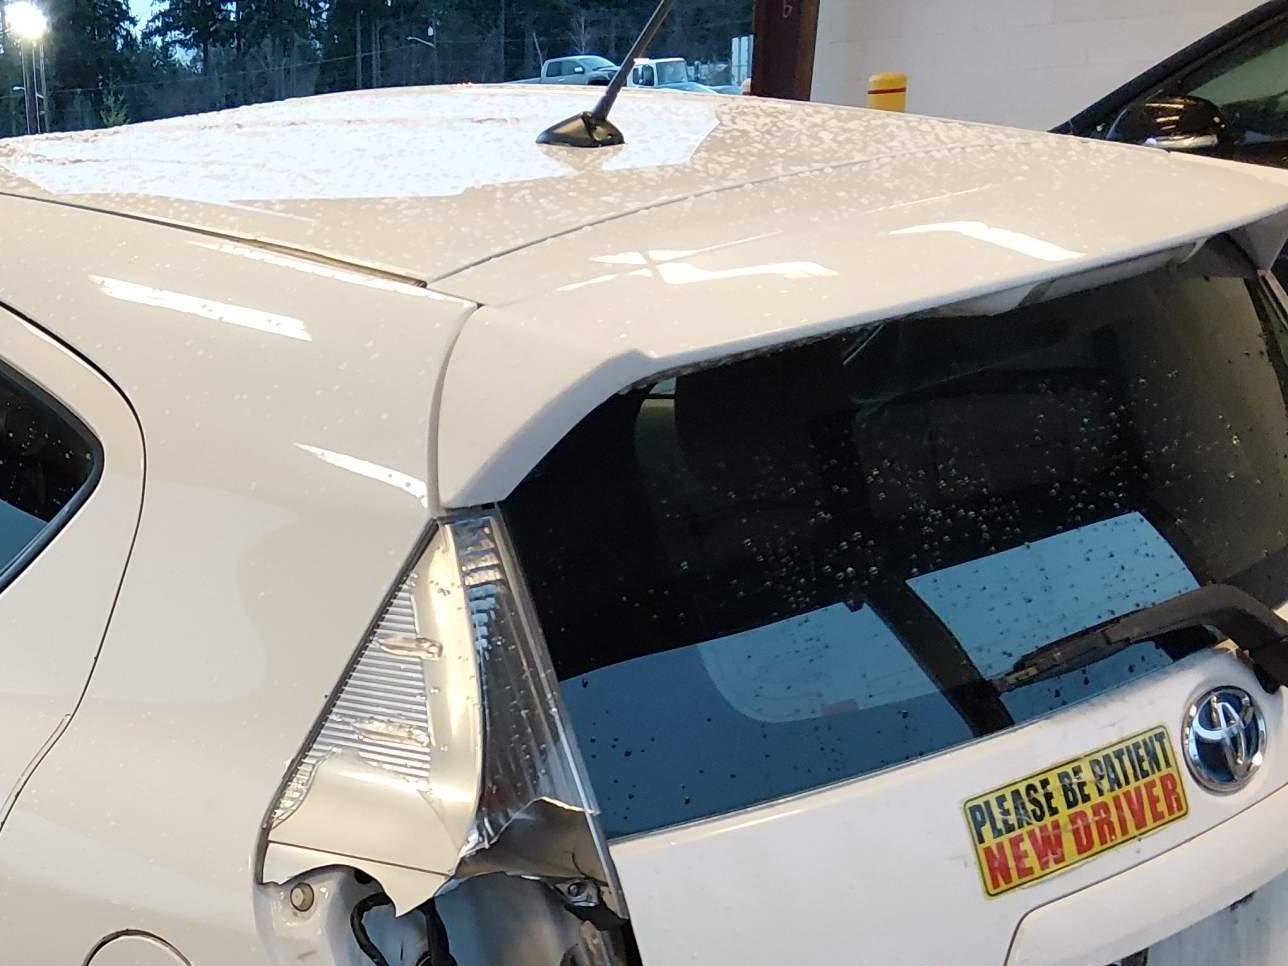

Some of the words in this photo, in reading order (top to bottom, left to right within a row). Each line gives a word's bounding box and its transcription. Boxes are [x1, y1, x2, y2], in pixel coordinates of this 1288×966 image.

[968, 778, 1059, 845] PLEASE
[1057, 764, 1091, 809] BE
[1089, 732, 1172, 797] PATIENT
[983, 820, 1066, 890] NEW
[1067, 772, 1183, 855] DRIVER
